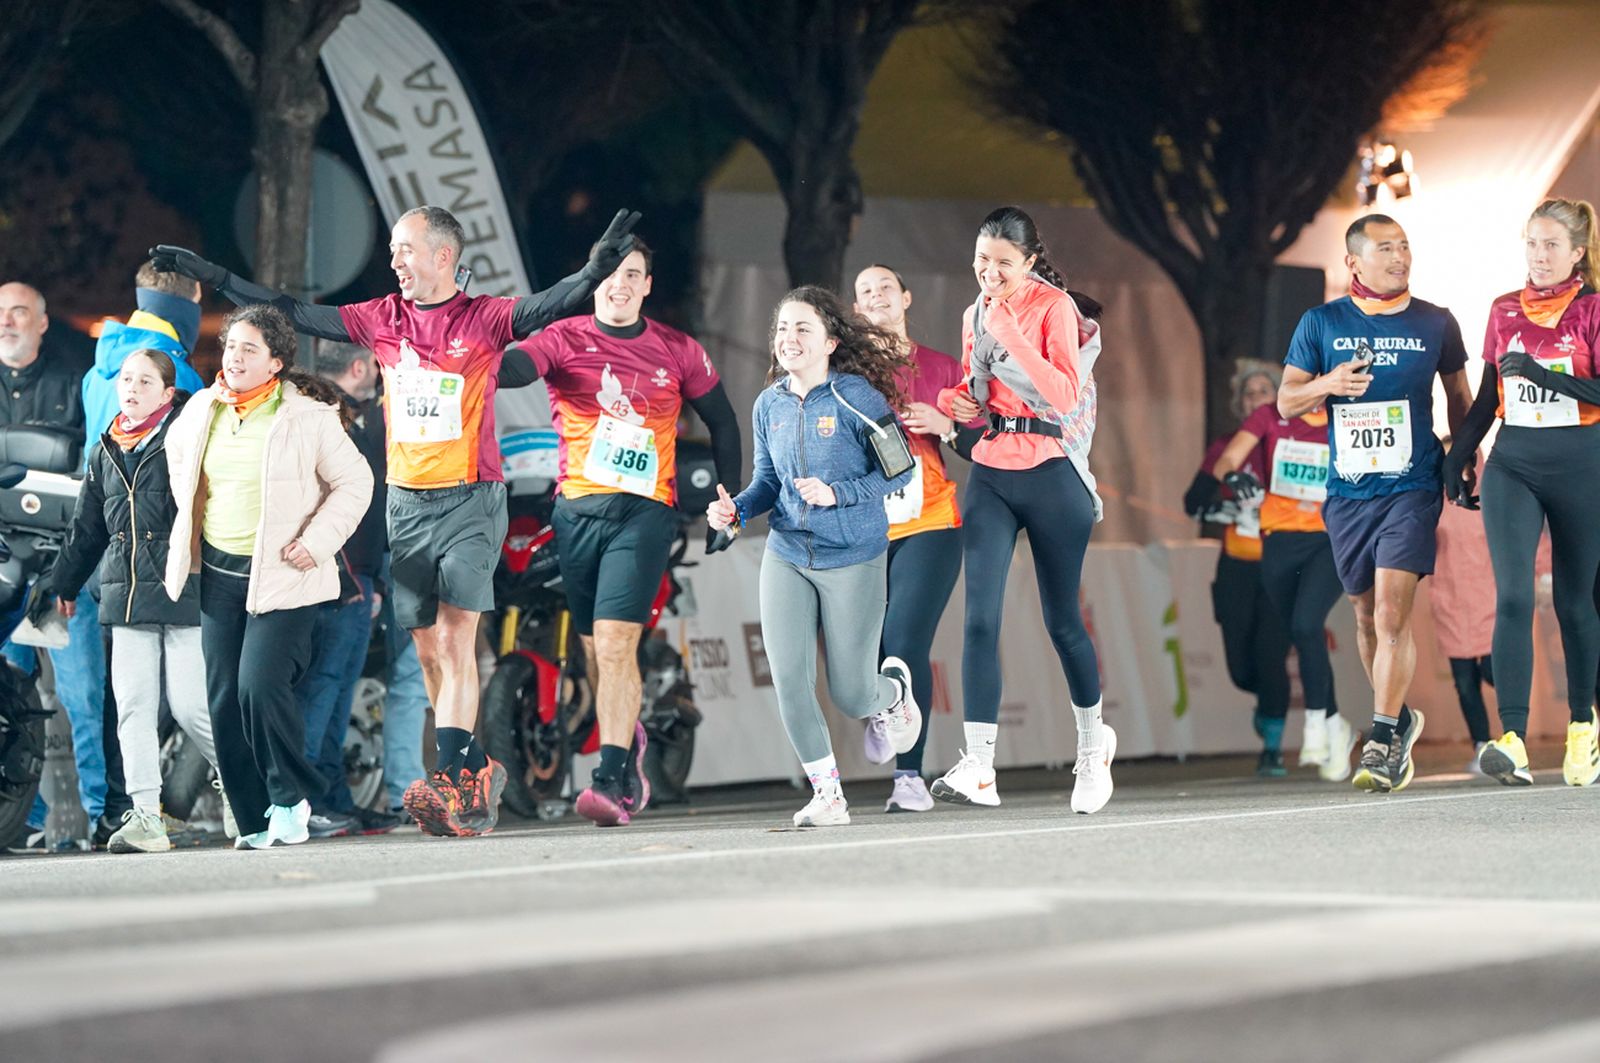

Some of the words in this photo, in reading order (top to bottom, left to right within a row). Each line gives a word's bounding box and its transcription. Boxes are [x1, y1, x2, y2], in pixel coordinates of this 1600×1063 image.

[403, 60, 516, 297] PEMASA
[1373, 337, 1426, 352] RURAL
[406, 396, 440, 417] 532
[611, 400, 630, 417] 43
[1350, 427, 1395, 449] 2073
[603, 442, 649, 472] 7936
[1283, 462, 1327, 482] 13739
